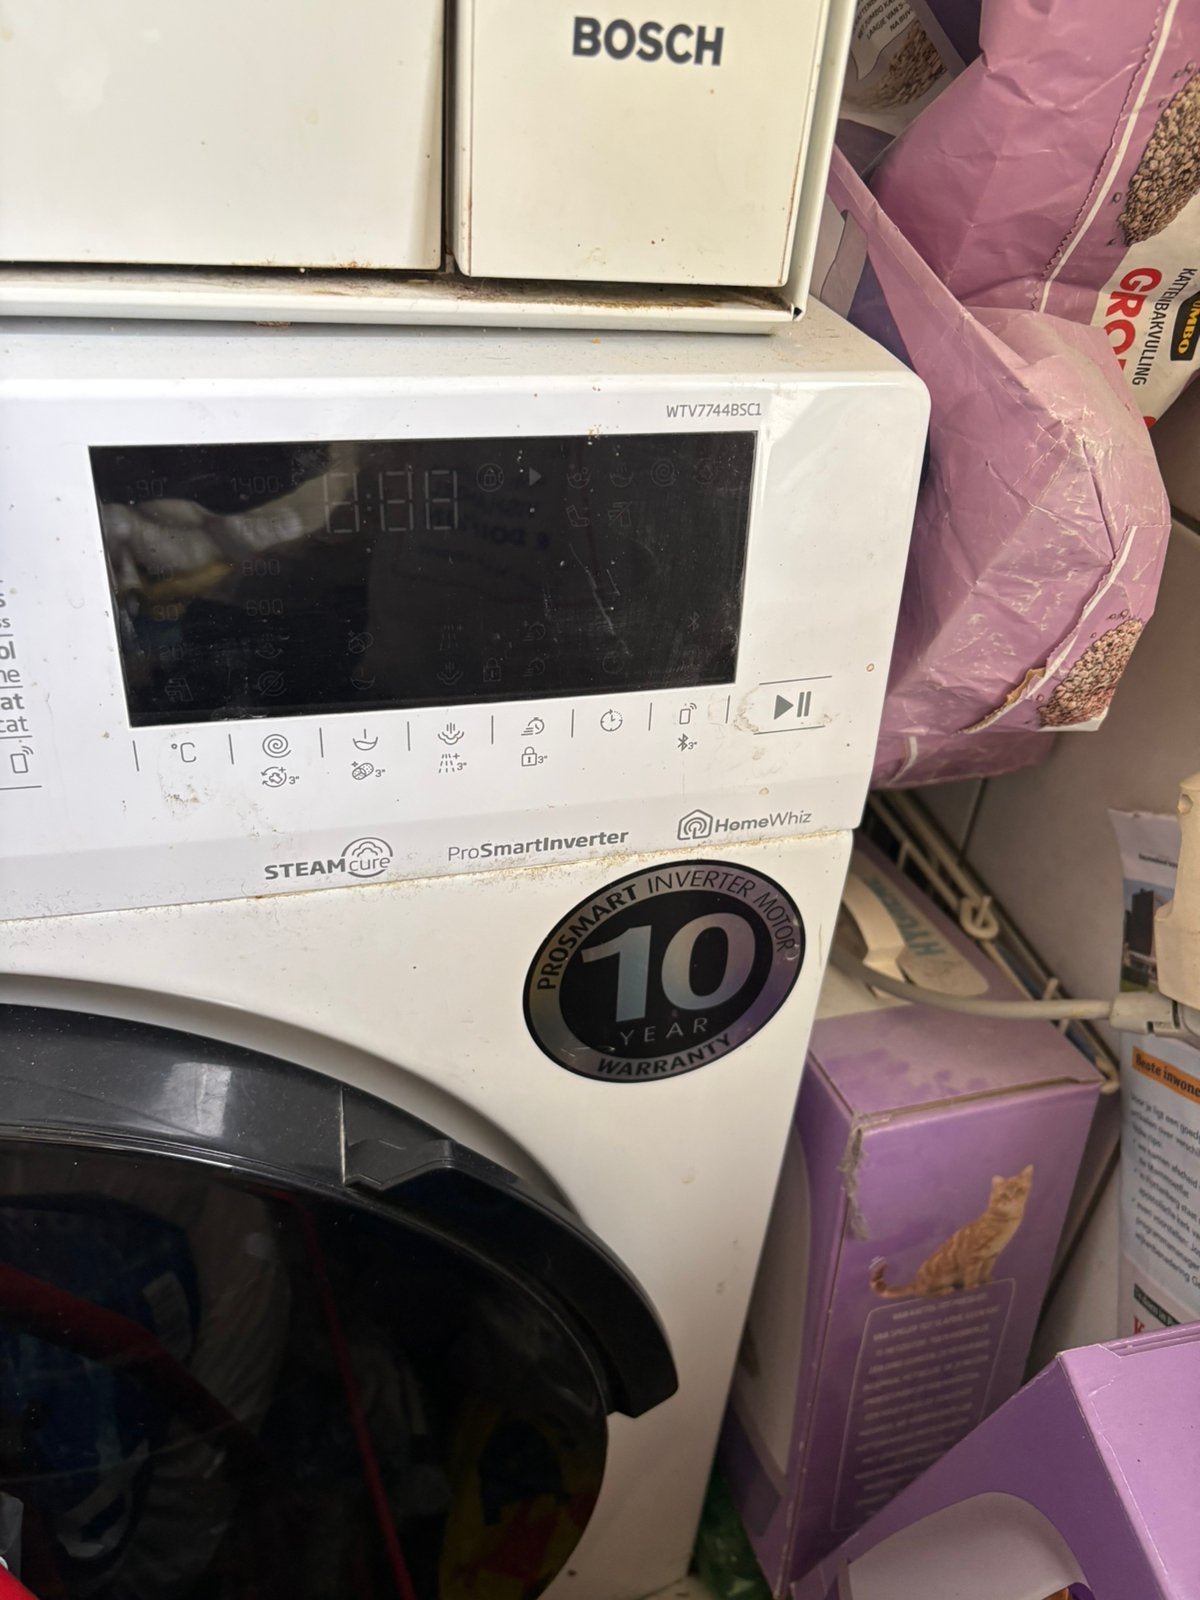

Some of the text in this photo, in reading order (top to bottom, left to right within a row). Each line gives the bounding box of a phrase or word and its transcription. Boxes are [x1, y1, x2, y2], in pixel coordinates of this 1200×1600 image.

[572, 16, 725, 67] BOSCH
[1103, 268, 1163, 371] GRO
[1132, 268, 1198, 386] KATTENBAKVULLING
[666, 402, 762, 418] WTV7744BSC1
[170, 742, 197, 763] °C
[714, 810, 813, 834] HomeWhiz
[448, 831, 629, 861] ProSmartInverter
[537, 883, 638, 990] PROSMART
[648, 869, 756, 899] INVERTER
[752, 891, 796, 952] MOTOR
[580, 911, 757, 1023] 10
[620, 1016, 708, 1047] YEAR
[597, 1033, 732, 1077] WARRANTY
